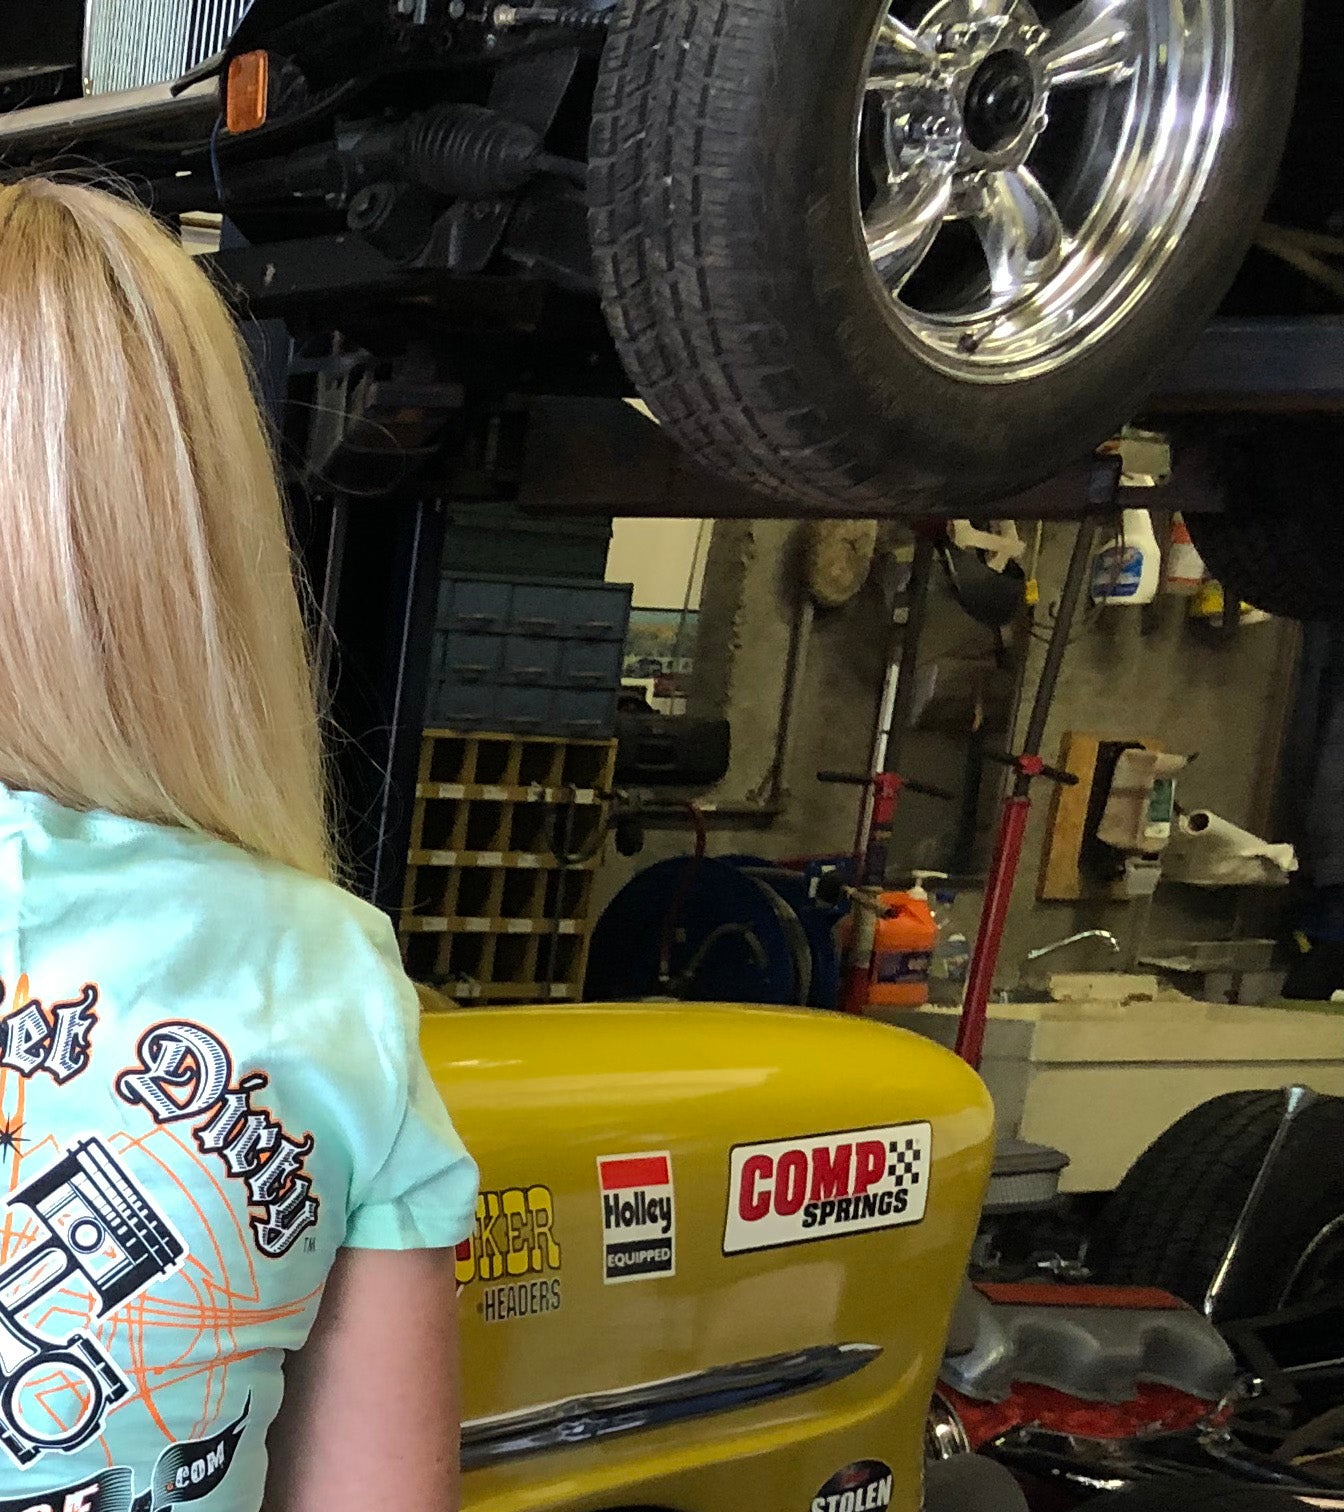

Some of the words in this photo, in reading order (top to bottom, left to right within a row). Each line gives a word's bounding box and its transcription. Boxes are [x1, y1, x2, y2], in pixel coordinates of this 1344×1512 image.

[114, 1018, 321, 1259] Dirty
[738, 1139, 887, 1222] COMP
[602, 1190, 672, 1235] Holley
[801, 1187, 910, 1229] SPRINGS
[606, 1247, 672, 1269] EQUIPPED
[484, 1278, 562, 1323] HEADERS
